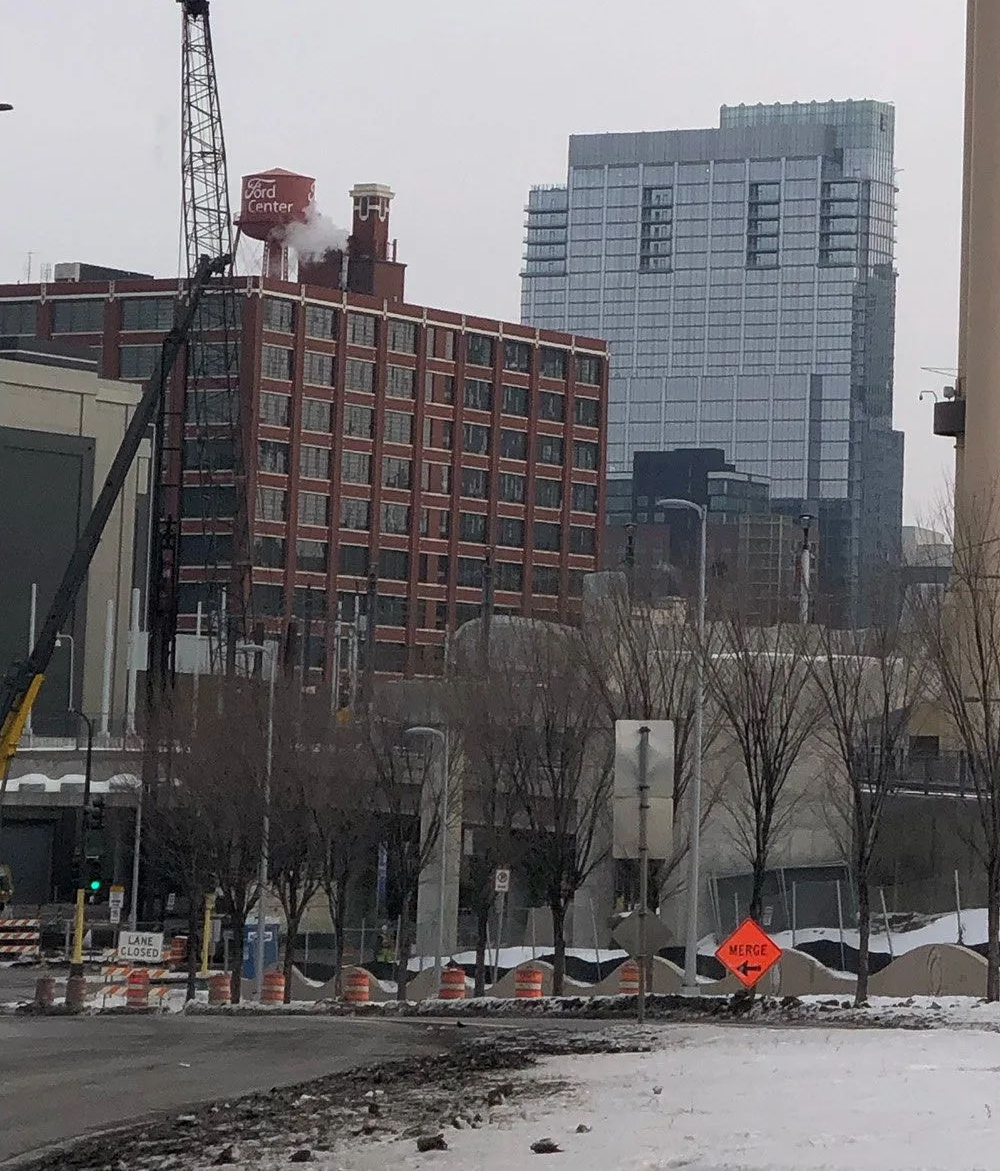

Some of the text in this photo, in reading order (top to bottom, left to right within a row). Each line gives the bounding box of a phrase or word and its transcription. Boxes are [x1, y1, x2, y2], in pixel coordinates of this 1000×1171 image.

[244, 178, 276, 199] Ford
[248, 200, 293, 213] Center
[128, 936, 153, 946] LANE
[120, 946, 159, 957] CLOSED
[729, 944, 768, 956] MERGE
